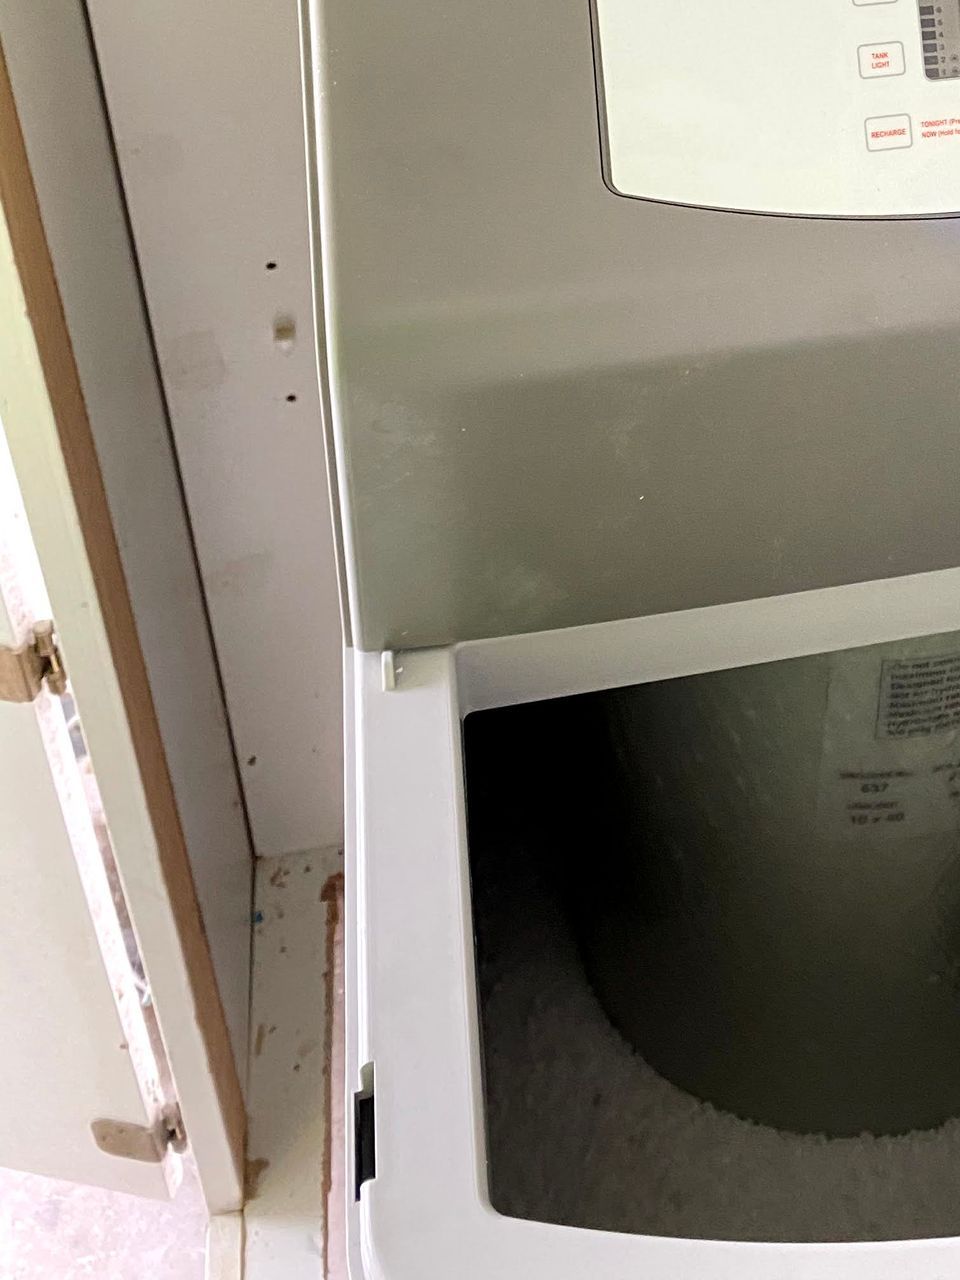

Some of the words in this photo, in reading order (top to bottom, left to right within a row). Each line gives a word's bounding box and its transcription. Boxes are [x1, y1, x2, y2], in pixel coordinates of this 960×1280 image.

[871, 60, 889, 69] LIGHT
[920, 119, 947, 127] TONIGHT
[870, 128, 906, 138] RECHARGE
[921, 130, 937, 138] NOW
[937, 129, 954, 137] (Hold
